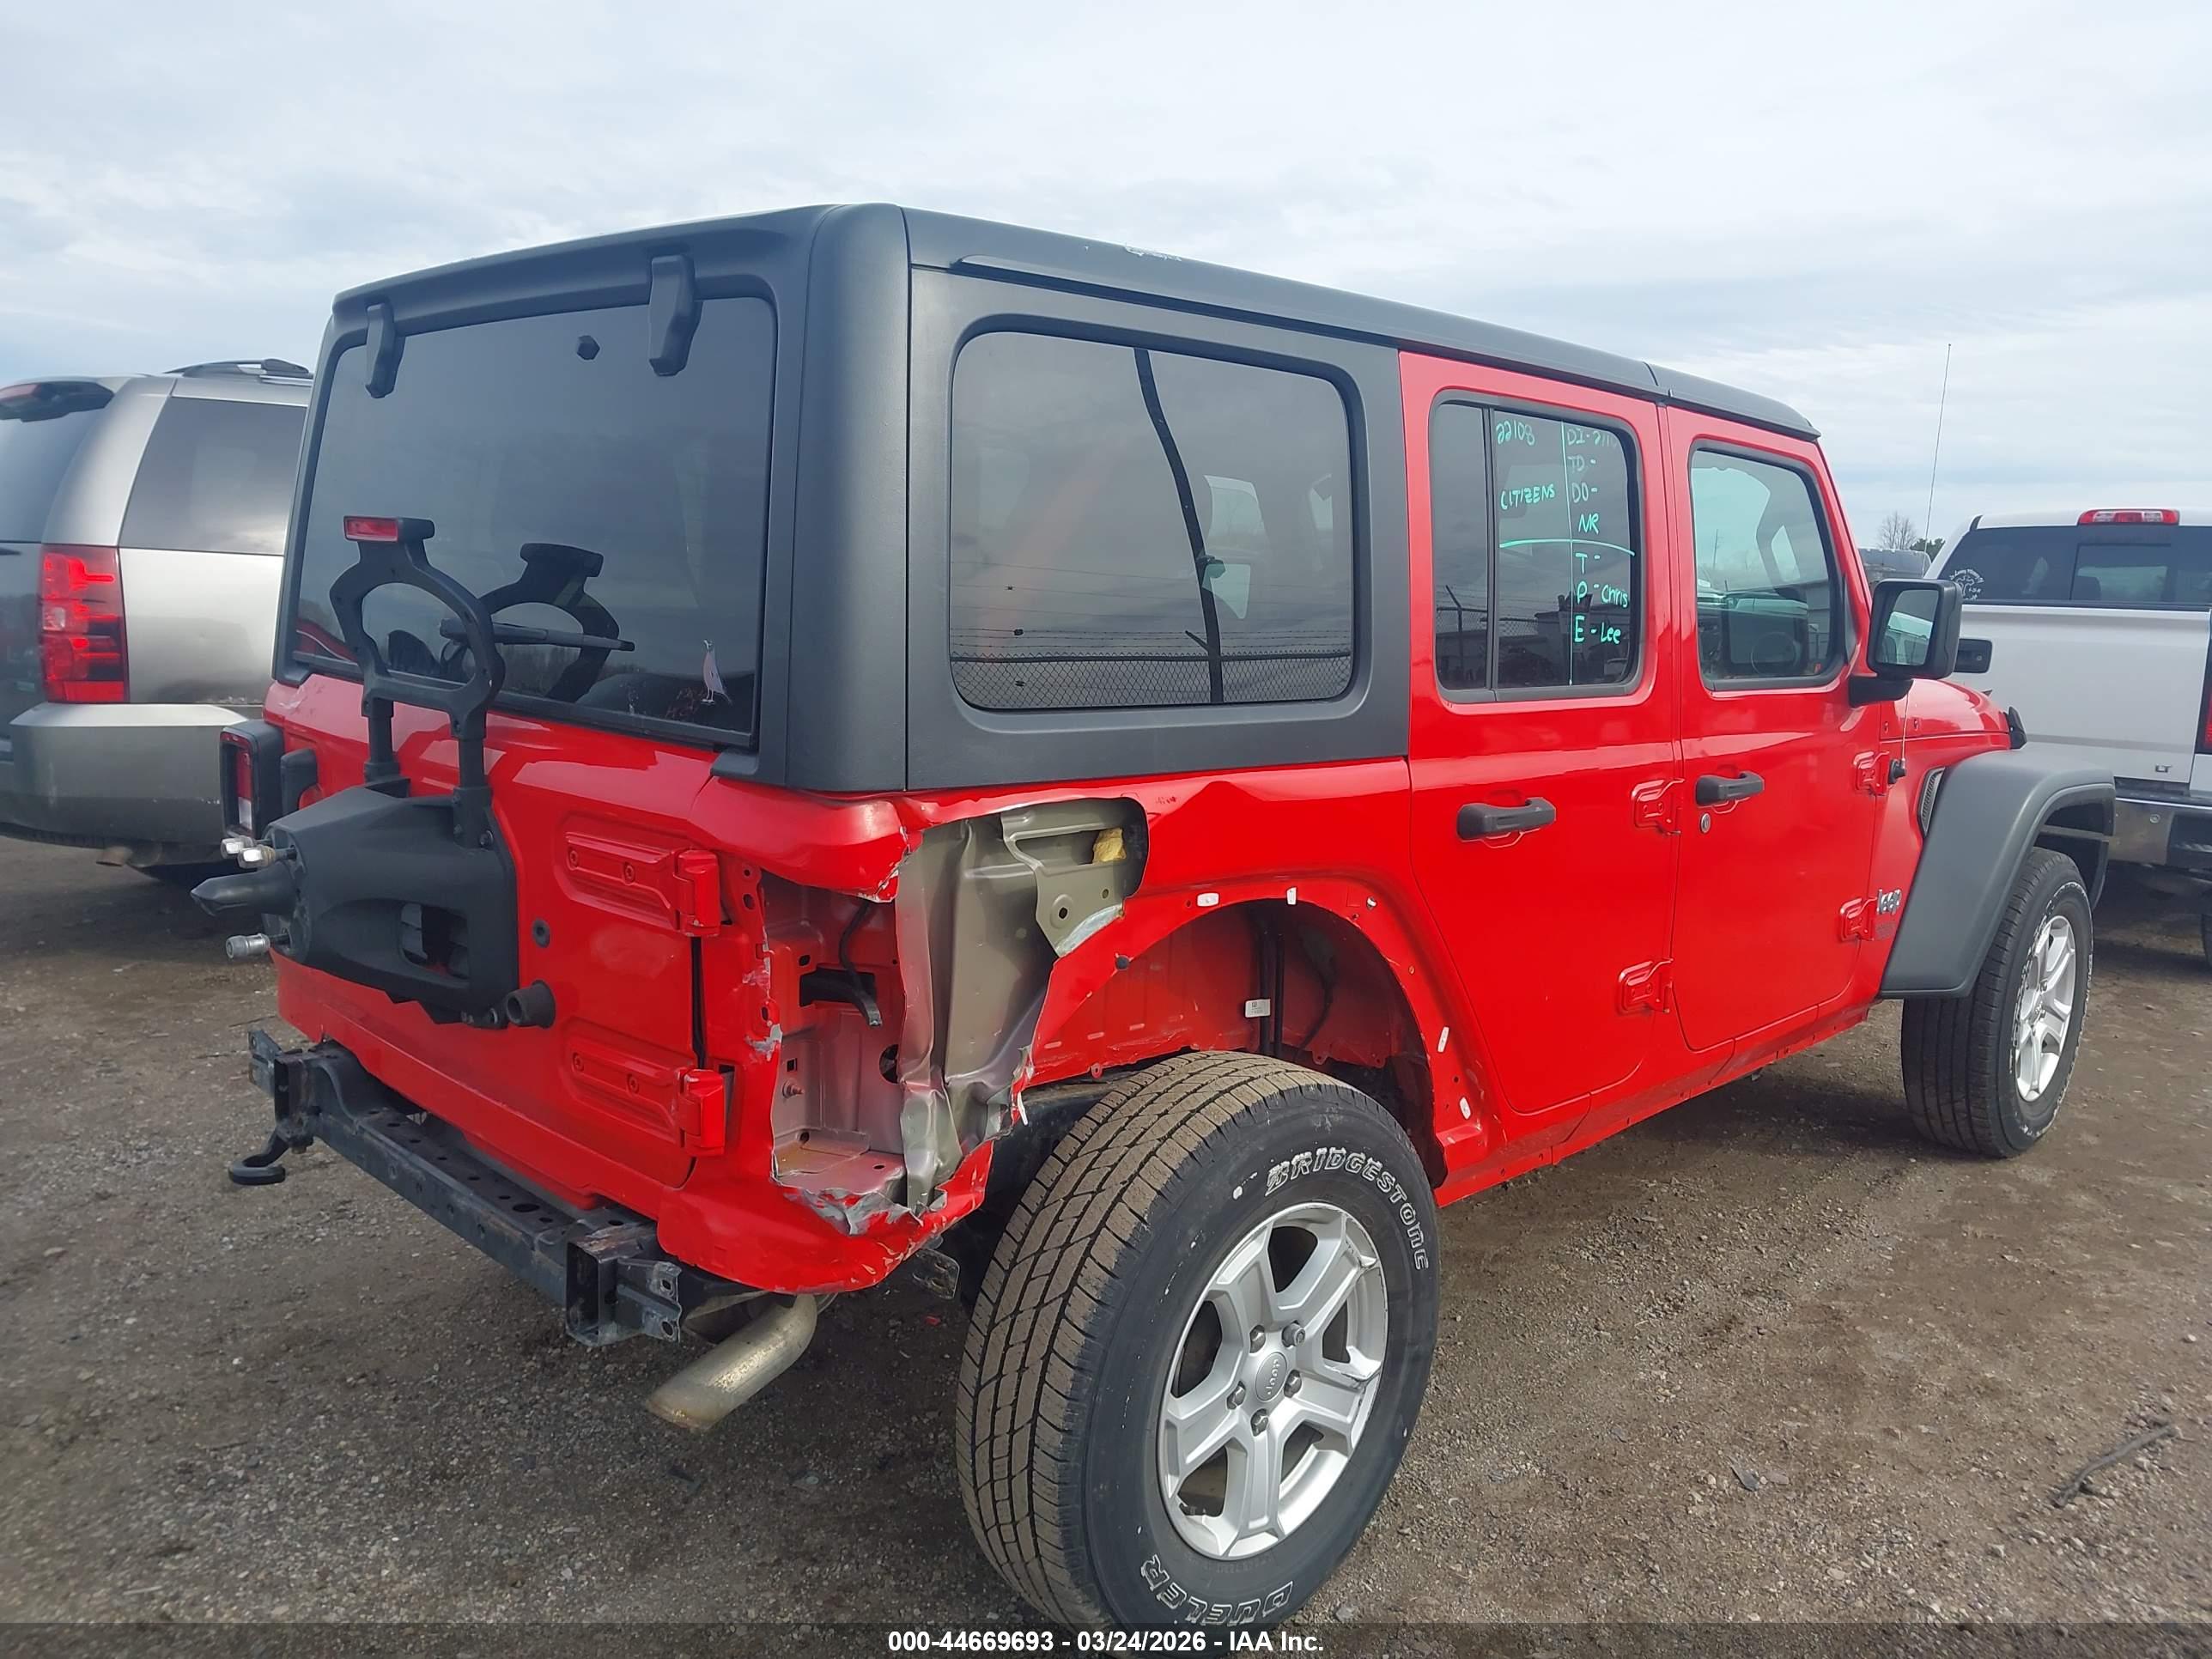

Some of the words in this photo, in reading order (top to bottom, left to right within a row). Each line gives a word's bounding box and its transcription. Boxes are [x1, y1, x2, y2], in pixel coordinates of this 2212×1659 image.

[1500, 483, 1555, 510] CITIZENS
[1578, 513, 1599, 534] NR
[1265, 1147, 1429, 1270] BRIDGESTONE
[1266, 1358, 1280, 1395] Jeep
[1140, 1553, 1294, 1626] DUELER
